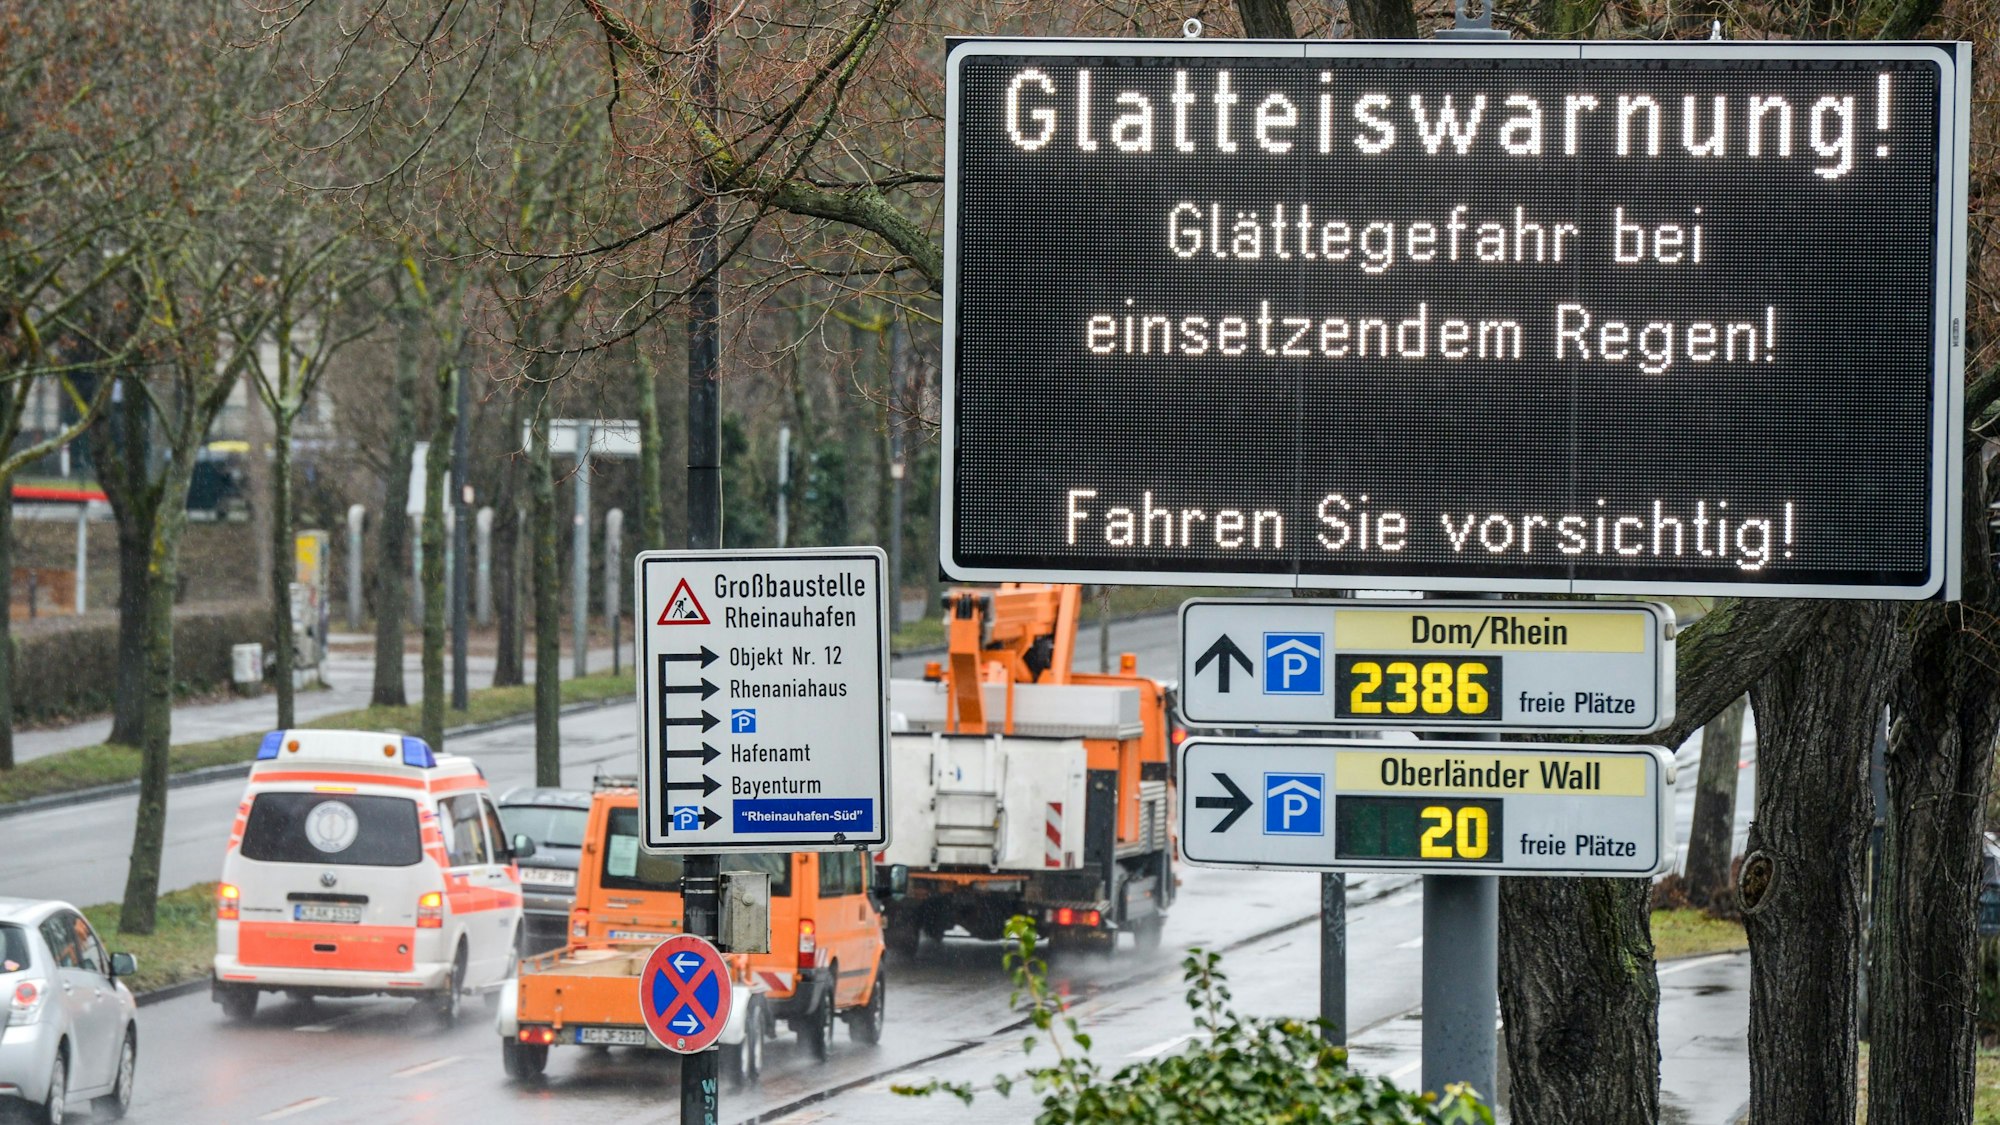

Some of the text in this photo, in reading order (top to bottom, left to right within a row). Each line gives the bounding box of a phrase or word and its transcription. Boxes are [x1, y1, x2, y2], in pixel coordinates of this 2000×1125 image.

[1007, 70, 1889, 178] Glatteiswarnung!
[1170, 203, 1700, 272] Glättegefahr bei
[1088, 299, 1773, 373] einsetzendem Regen!
[1068, 490, 1792, 570] Fahren Sie vorsichtig!
[715, 573, 864, 598] Großbaustelle
[726, 606, 855, 628] Rheinauhafen
[1413, 616, 1566, 648] Dom/Rhein
[731, 646, 841, 670] Objekt Nr. 12
[731, 679, 846, 698] Rhenaniahaus
[1351, 663, 1488, 713] 2386
[1520, 692, 1635, 713] freie Plätze
[732, 744, 810, 762] Hafenamt
[733, 776, 820, 798] Bayenturm
[1382, 758, 1599, 789] Oberländer Wall
[1421, 807, 1487, 858] 20
[1520, 834, 1635, 856] freie Plätze
